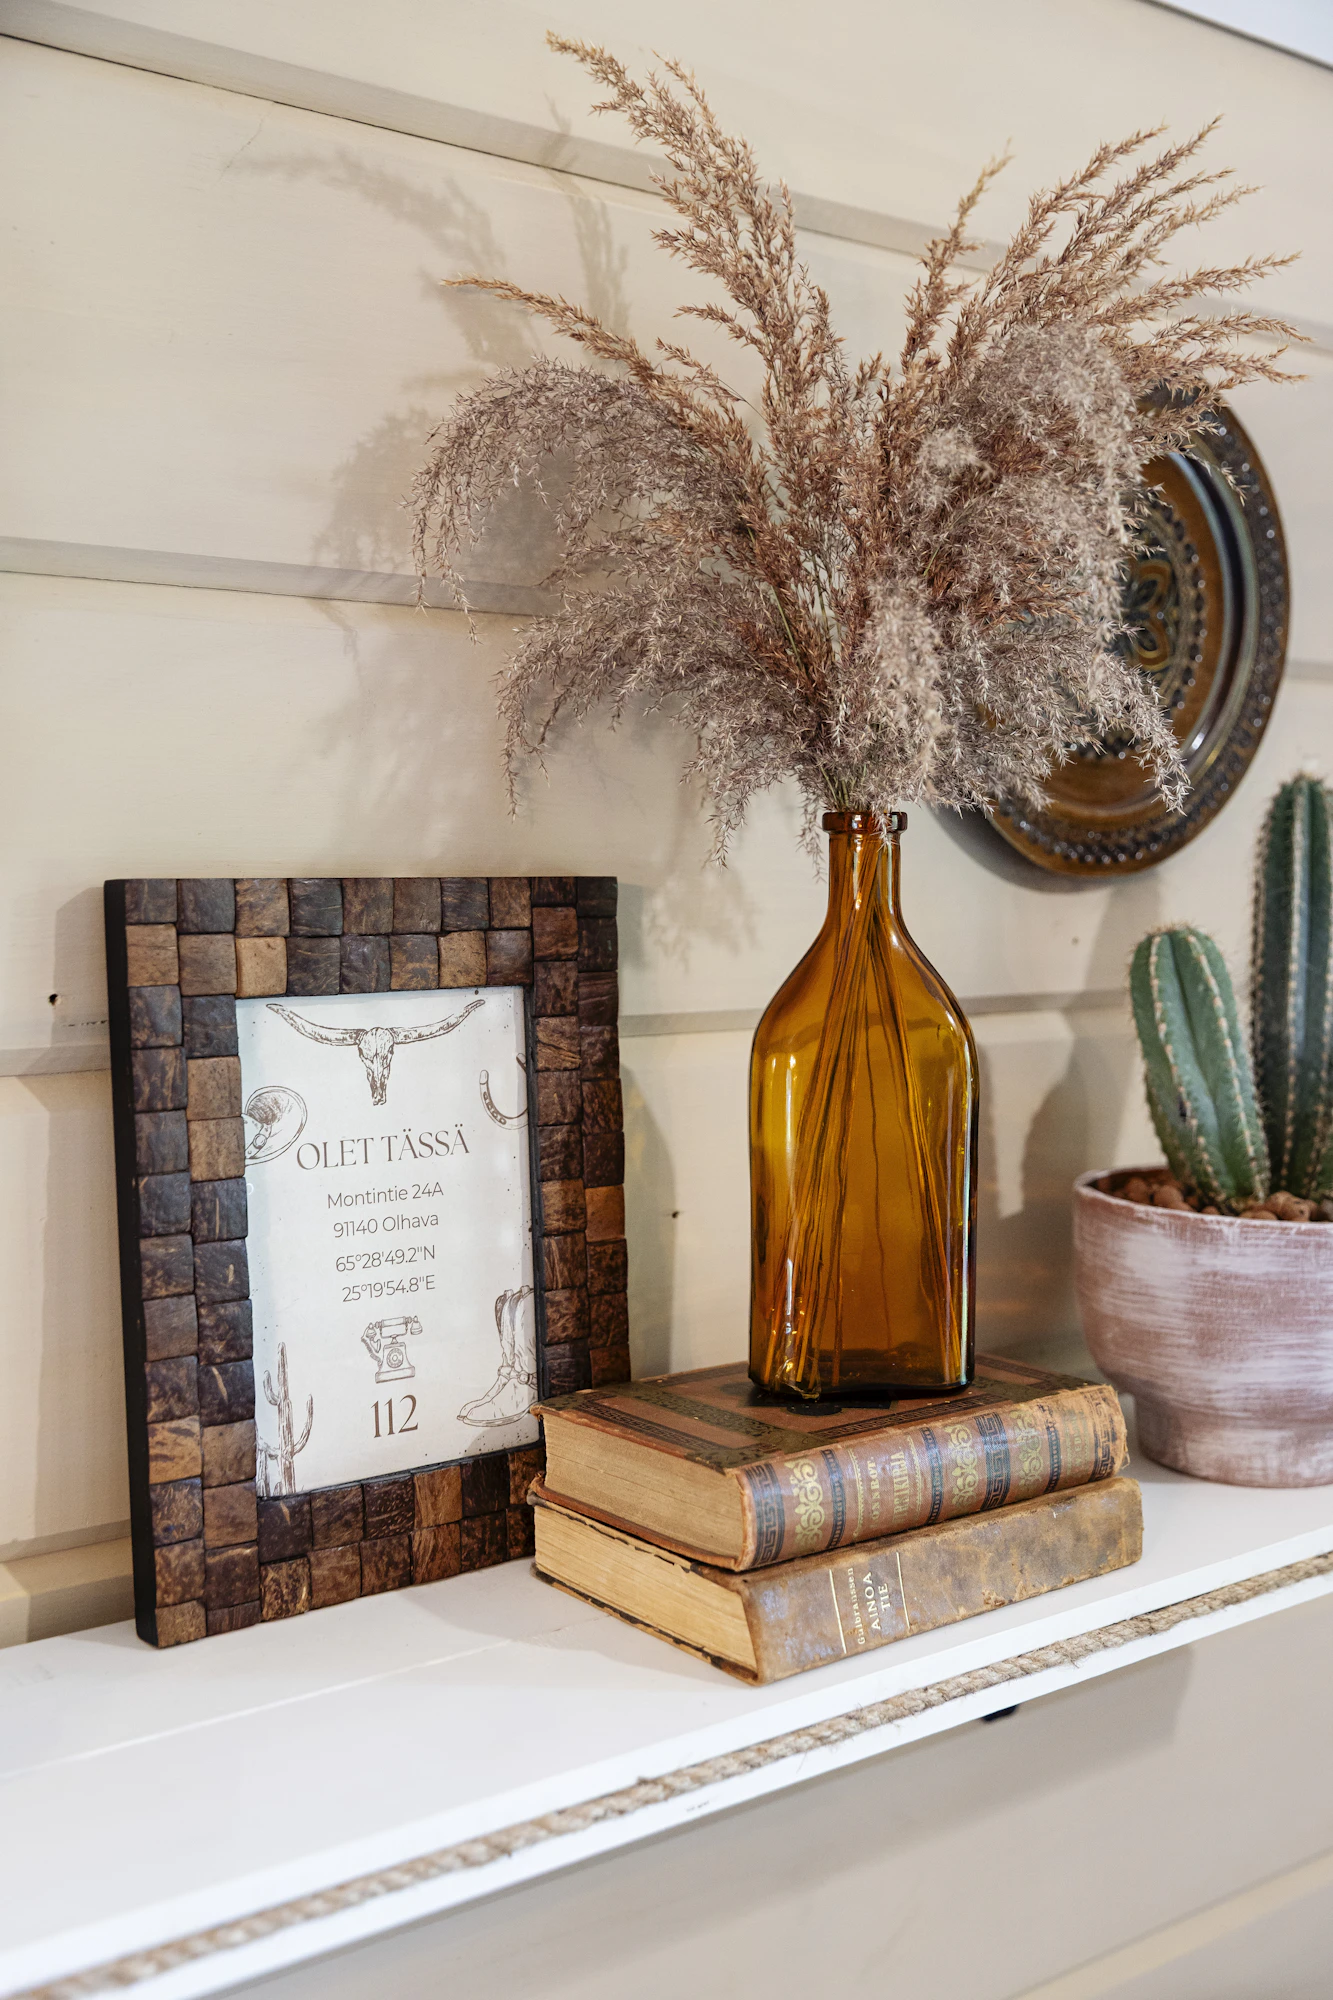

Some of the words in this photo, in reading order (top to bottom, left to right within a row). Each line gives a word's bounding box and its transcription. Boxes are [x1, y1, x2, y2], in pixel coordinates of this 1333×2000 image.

[296, 1137, 375, 1171] OLET
[380, 1123, 471, 1162] TÄSSÄ
[327, 1185, 408, 1209] Montintie
[411, 1181, 444, 1199] 24A
[333, 1218, 378, 1238] 91140
[382, 1214, 439, 1231] Olhava
[335, 1244, 435, 1272] 65°28'49.2"N
[341, 1274, 436, 1302] 25°19'54.8"E
[370, 1394, 419, 1439] 112
[847, 1567, 866, 1645] Gulbranssen
[863, 1571, 881, 1630] AINOA
[878, 1583, 891, 1612] TIE
